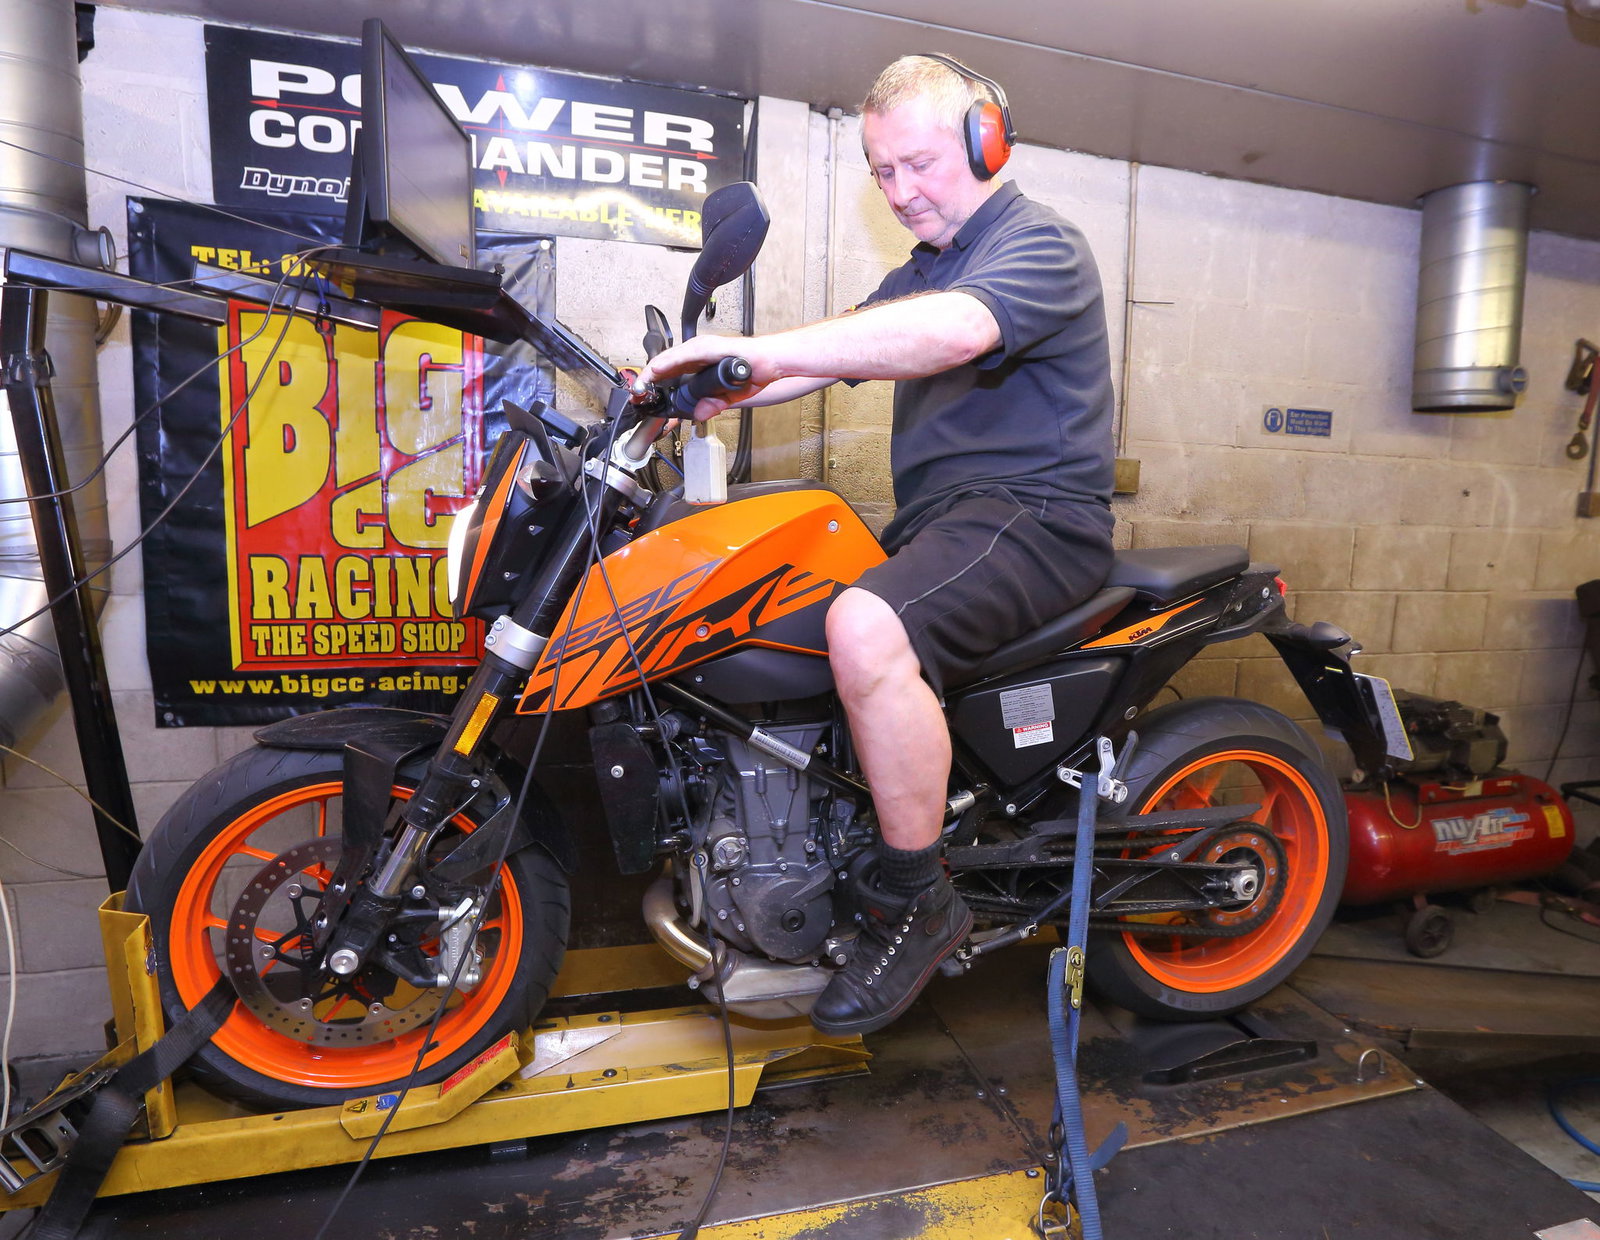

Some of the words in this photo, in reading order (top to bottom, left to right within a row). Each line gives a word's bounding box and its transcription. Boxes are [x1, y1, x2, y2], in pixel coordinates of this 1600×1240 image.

[248, 109, 707, 194] COANDER
[240, 166, 351, 203] Dynoj
[645, 206, 702, 231] HER
[240, 311, 464, 528] BIG
[252, 624, 307, 656] THE
[315, 623, 396, 655] SPEED
[404, 622, 466, 653] SHOP
